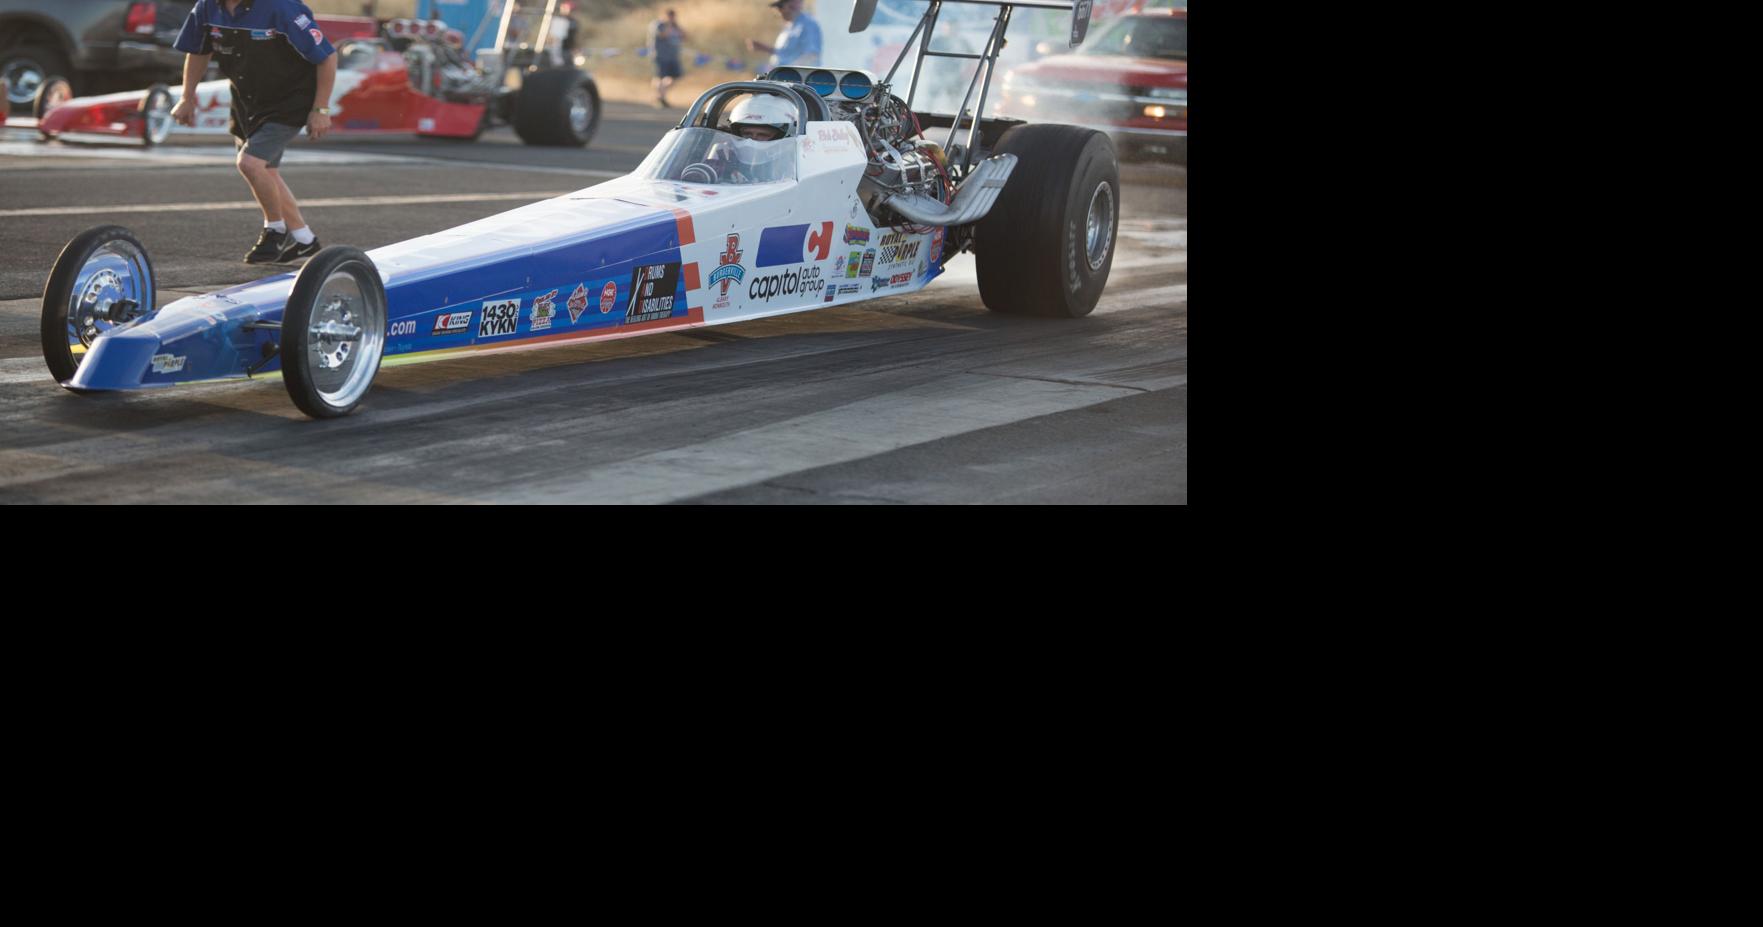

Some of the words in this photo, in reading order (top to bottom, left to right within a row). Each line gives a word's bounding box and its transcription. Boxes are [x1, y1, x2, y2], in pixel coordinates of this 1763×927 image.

[749, 266, 802, 302] capitol
[802, 265, 820, 279] auto
[800, 279, 824, 298] group
[449, 312, 471, 326] KING
[482, 303, 516, 321] 1430
[480, 317, 517, 336] KYKN
